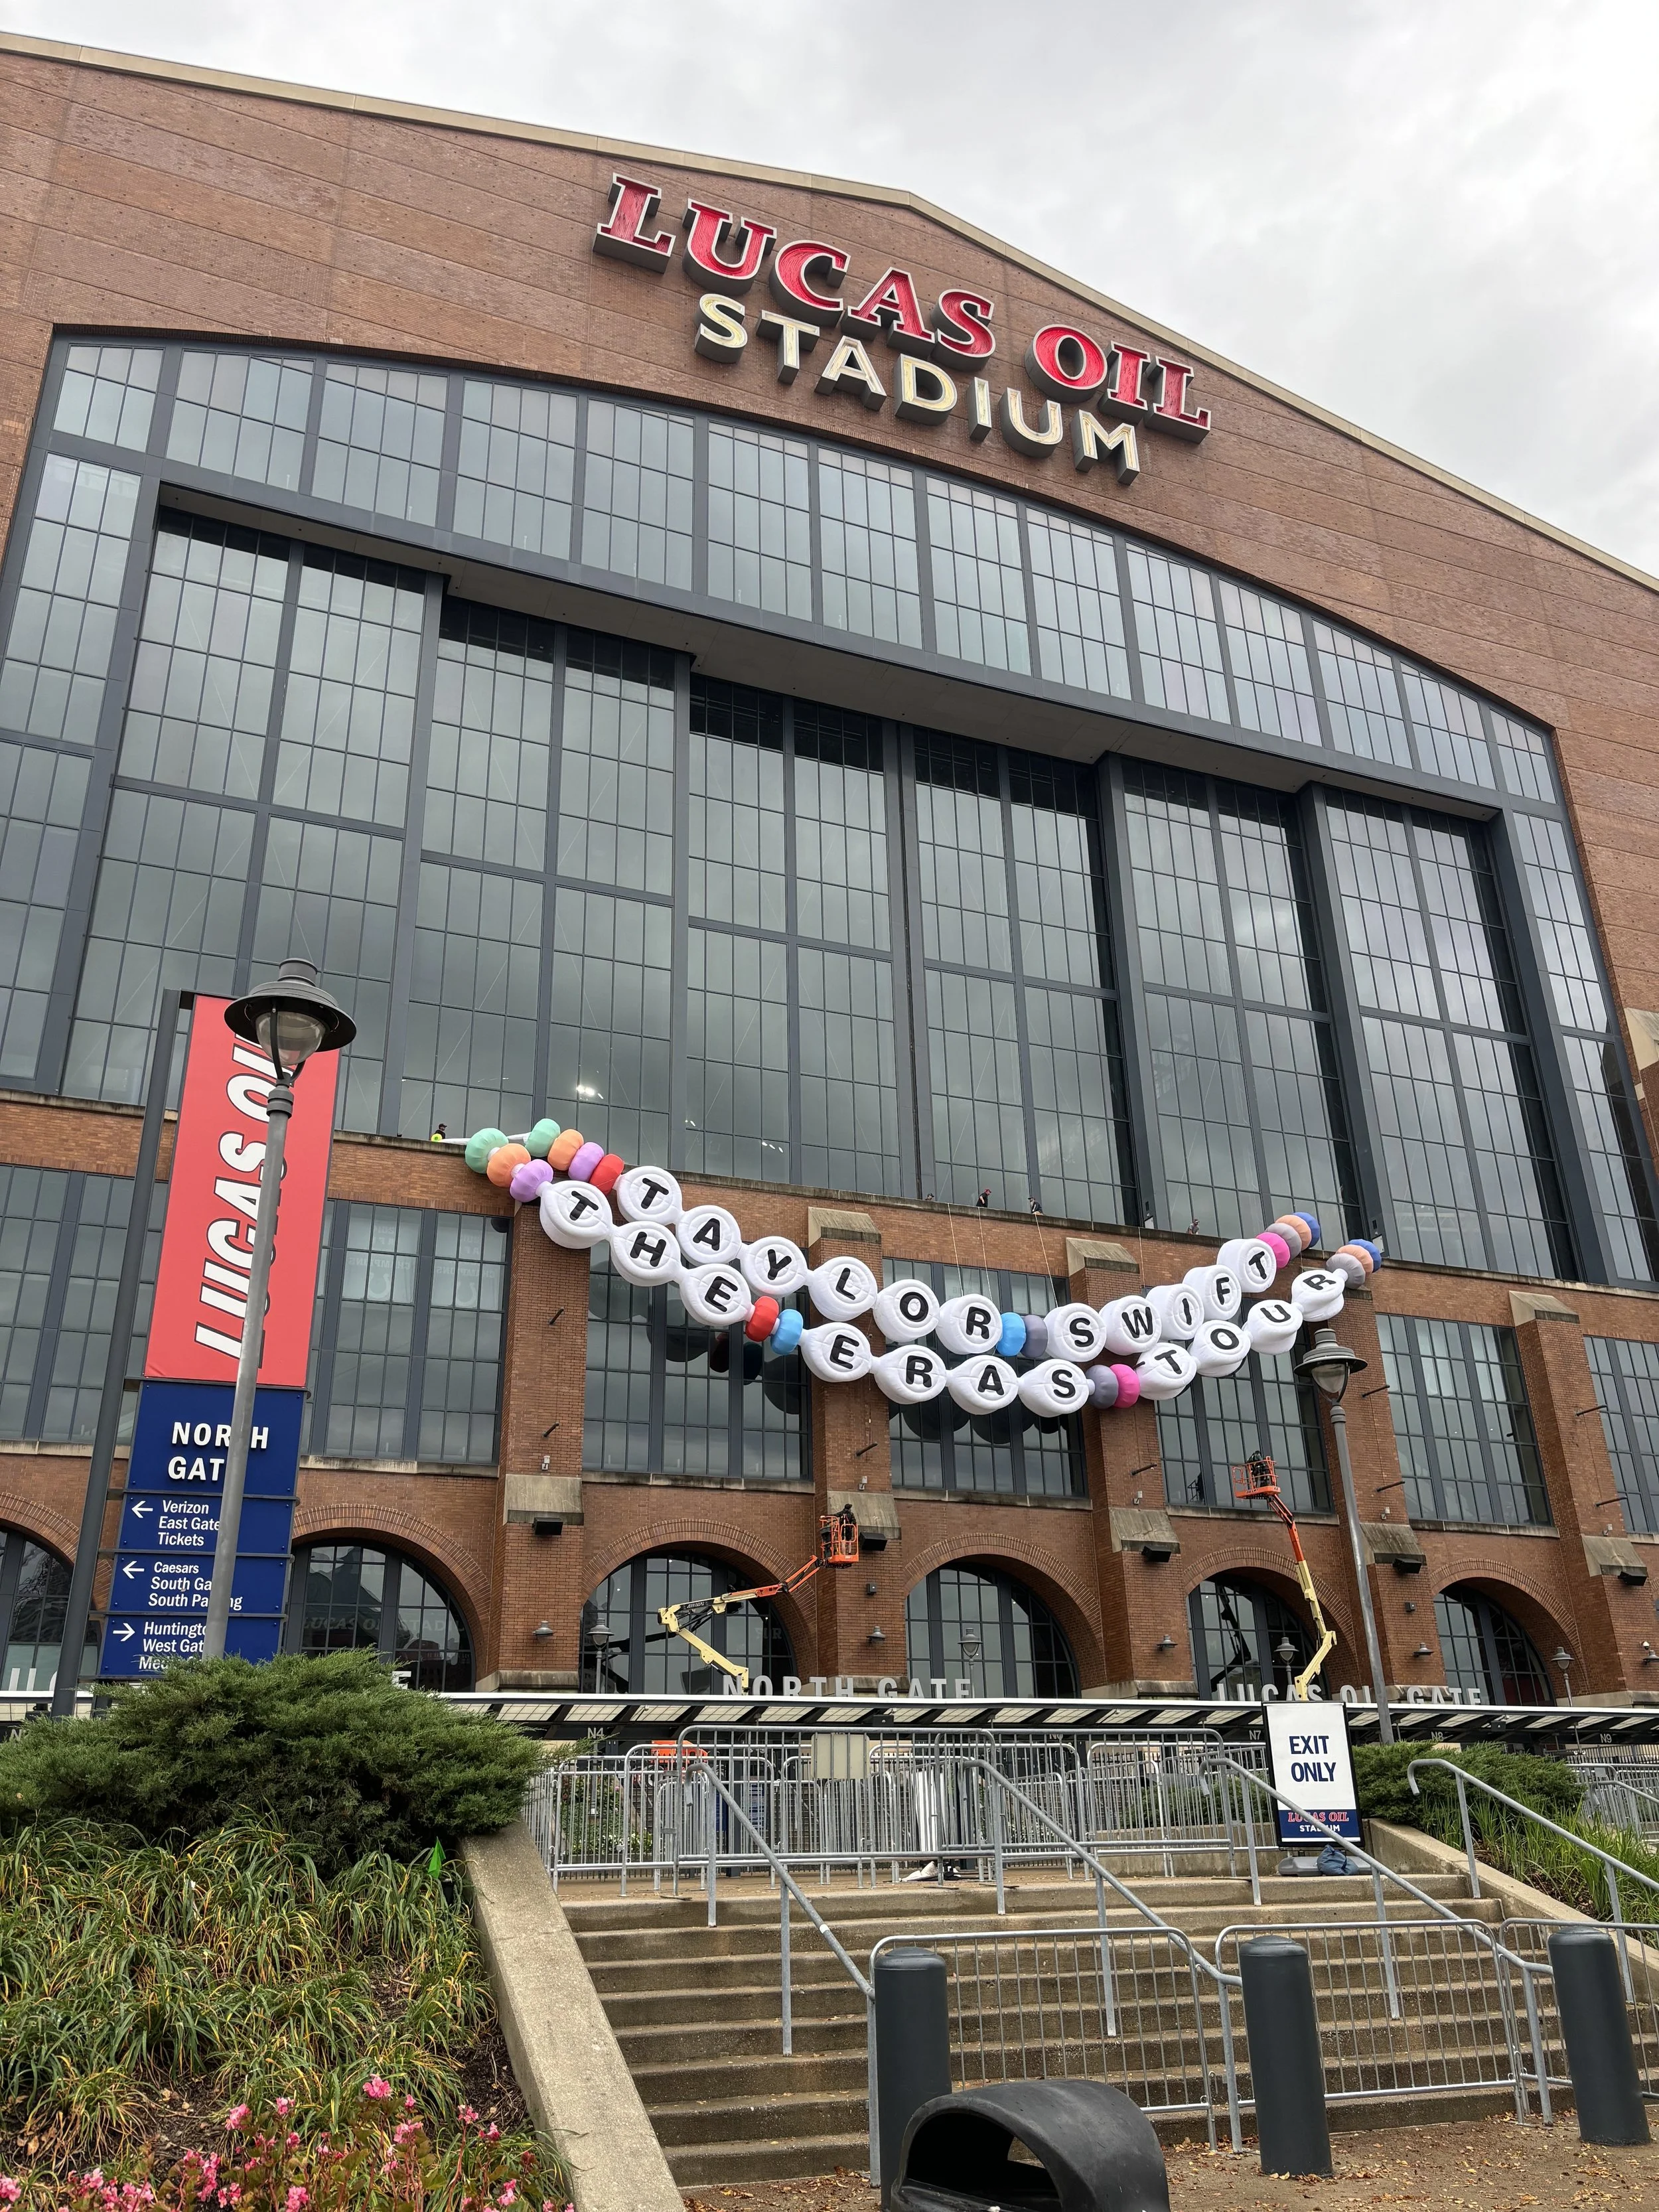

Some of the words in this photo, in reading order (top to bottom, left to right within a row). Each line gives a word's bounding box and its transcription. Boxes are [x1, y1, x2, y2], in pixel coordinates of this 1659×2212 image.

[594, 172, 995, 365] LUCAS
[1027, 323, 1212, 438] OIL
[695, 293, 1141, 481] STADIUM
[639, 1177, 992, 1340] TAYLOR
[1068, 1250, 1267, 1348] SWIFT
[569, 1190, 739, 1313] THE
[828, 1333, 1076, 1399] ERAS
[1155, 1274, 1336, 1375] TOUR
[171, 1422, 269, 1449] NORH
[168, 1455, 225, 1481] GAT
[162, 1499, 210, 1514] Verizon
[159, 1515, 188, 1530] East
[190, 1516, 220, 1531] Gate
[157, 1532, 204, 1547] Tickets
[153, 1561, 200, 1574] Caesars
[150, 1576, 191, 1591] South
[194, 1577, 213, 1591] Ga
[148, 1592, 189, 1607] South
[191, 1593, 244, 1611] Pang
[143, 1621, 207, 1639] Huntingt
[143, 1638, 178, 1653] West
[179, 1638, 204, 1653] Gat
[722, 1674, 855, 1697] NORTH
[877, 1676, 972, 1699] GATE
[1406, 1686, 1481, 1706] GATE
[587, 1727, 605, 1739] N4
[1249, 1729, 1262, 1741] N7
[1431, 1731, 1444, 1742] N8
[1600, 1733, 1613, 1743] N9
[1288, 1735, 1330, 1755] EXIT
[1290, 1761, 1336, 1783] ONLY
[1287, 1811, 1327, 1823] LUAS
[1328, 1811, 1350, 1822] OIL
[1299, 1824, 1340, 1832] STAUM
